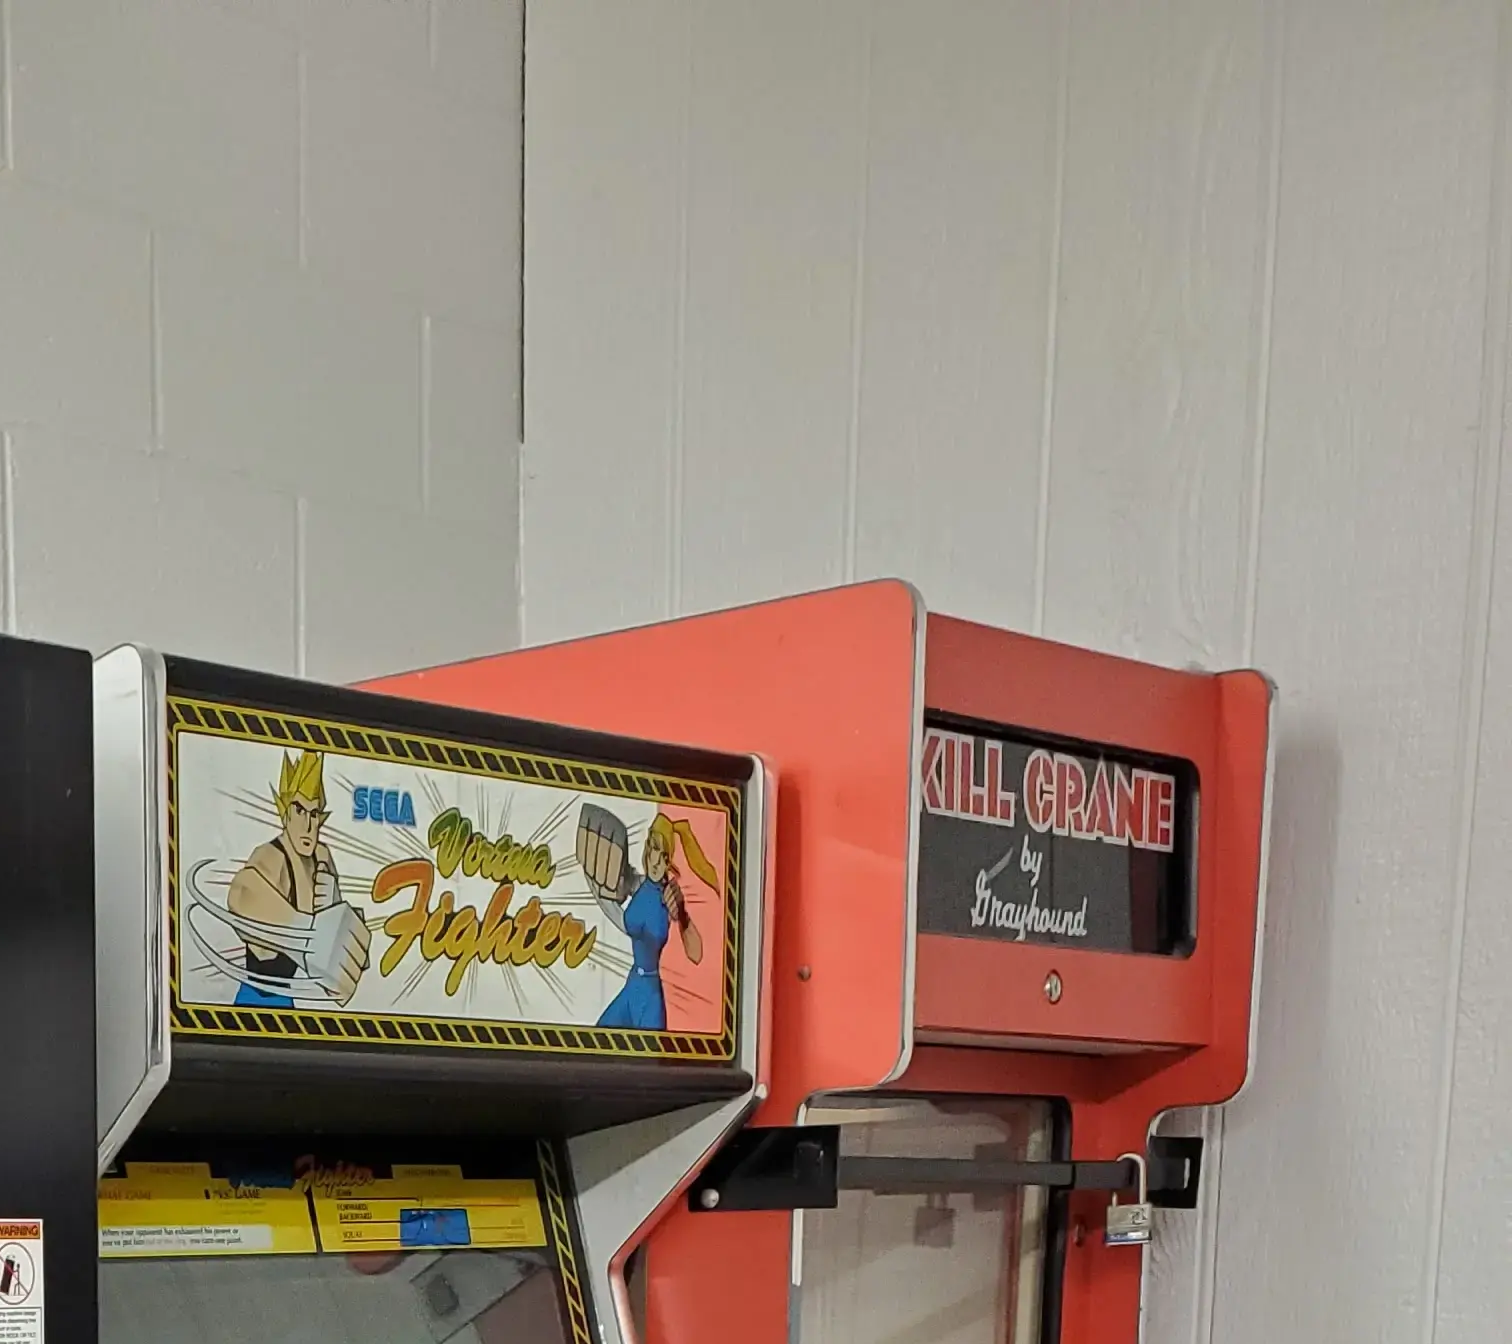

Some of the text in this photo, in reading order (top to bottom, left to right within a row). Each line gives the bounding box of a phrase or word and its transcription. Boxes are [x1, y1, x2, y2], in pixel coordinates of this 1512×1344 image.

[351, 785, 416, 828] SEGA
[1023, 749, 1176, 853] CRANE
[428, 807, 556, 890] Virtua
[1019, 834, 1043, 887] by
[371, 859, 597, 996] Fighter
